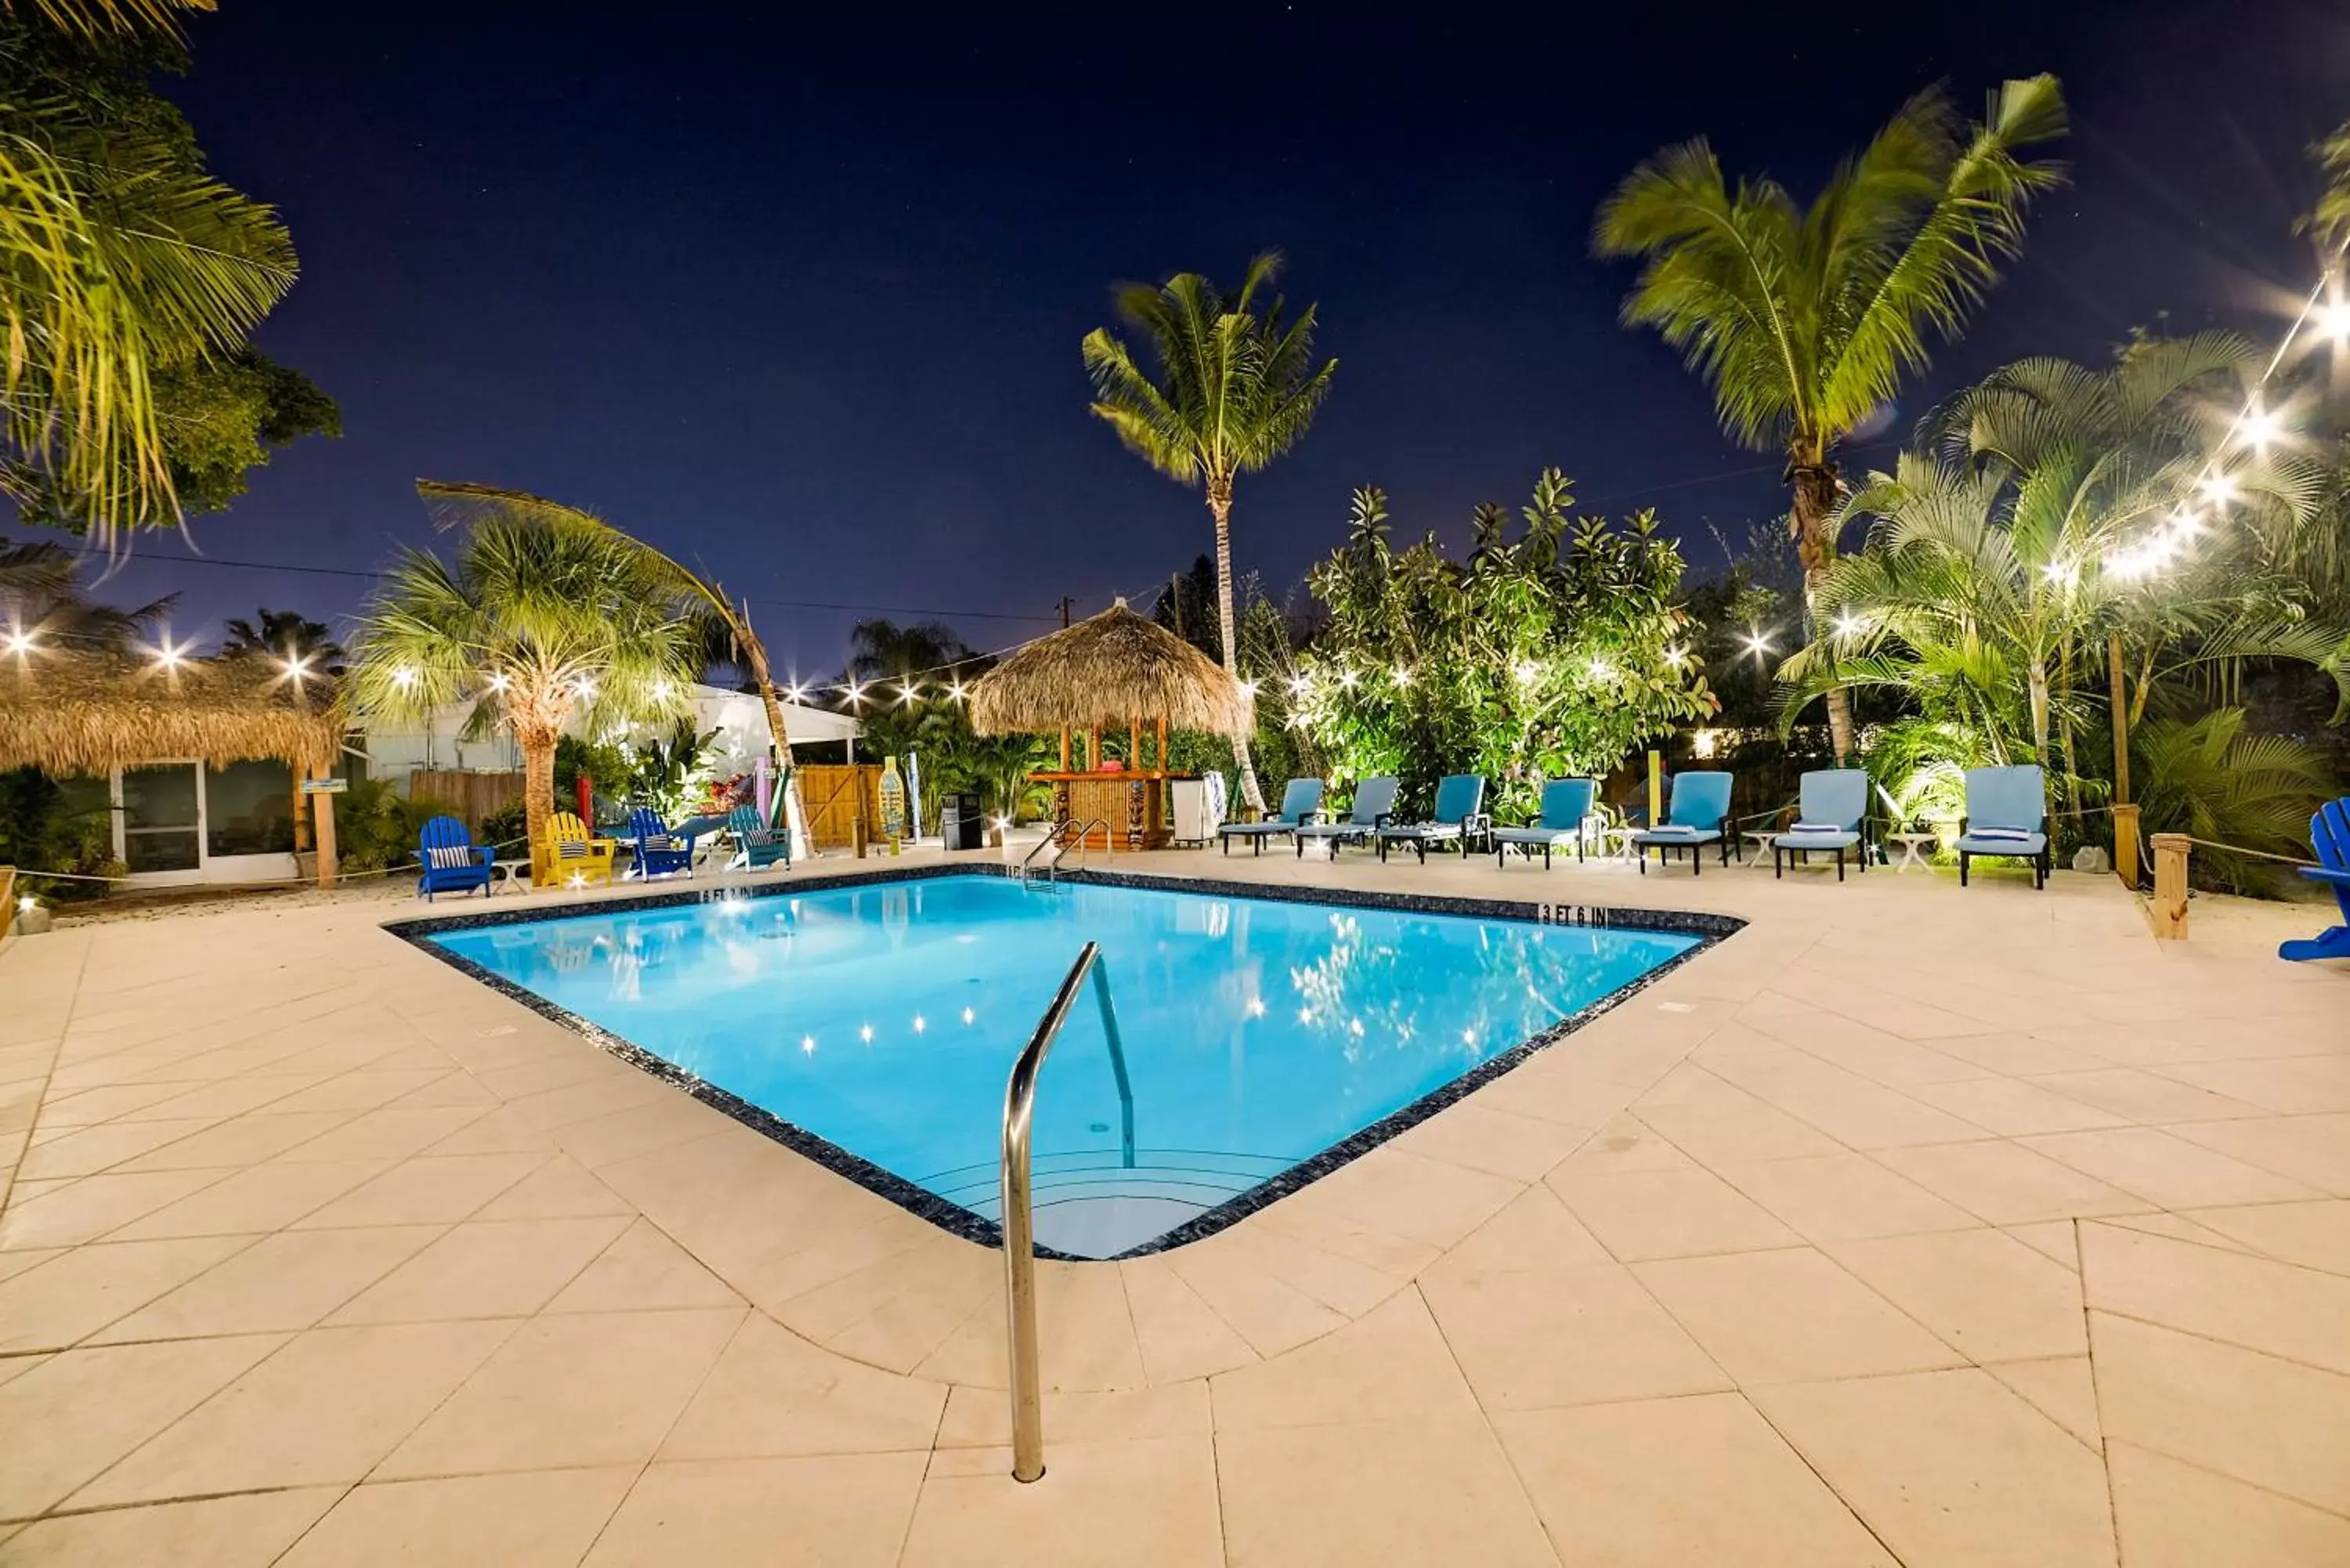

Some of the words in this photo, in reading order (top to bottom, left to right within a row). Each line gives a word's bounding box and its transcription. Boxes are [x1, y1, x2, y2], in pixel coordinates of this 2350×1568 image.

[714, 888, 725, 901] FT
[1543, 905, 1550, 924] 3
[1556, 905, 1571, 925] FT
[1578, 906, 1585, 927] 6
[1591, 907, 1606, 928] IN
